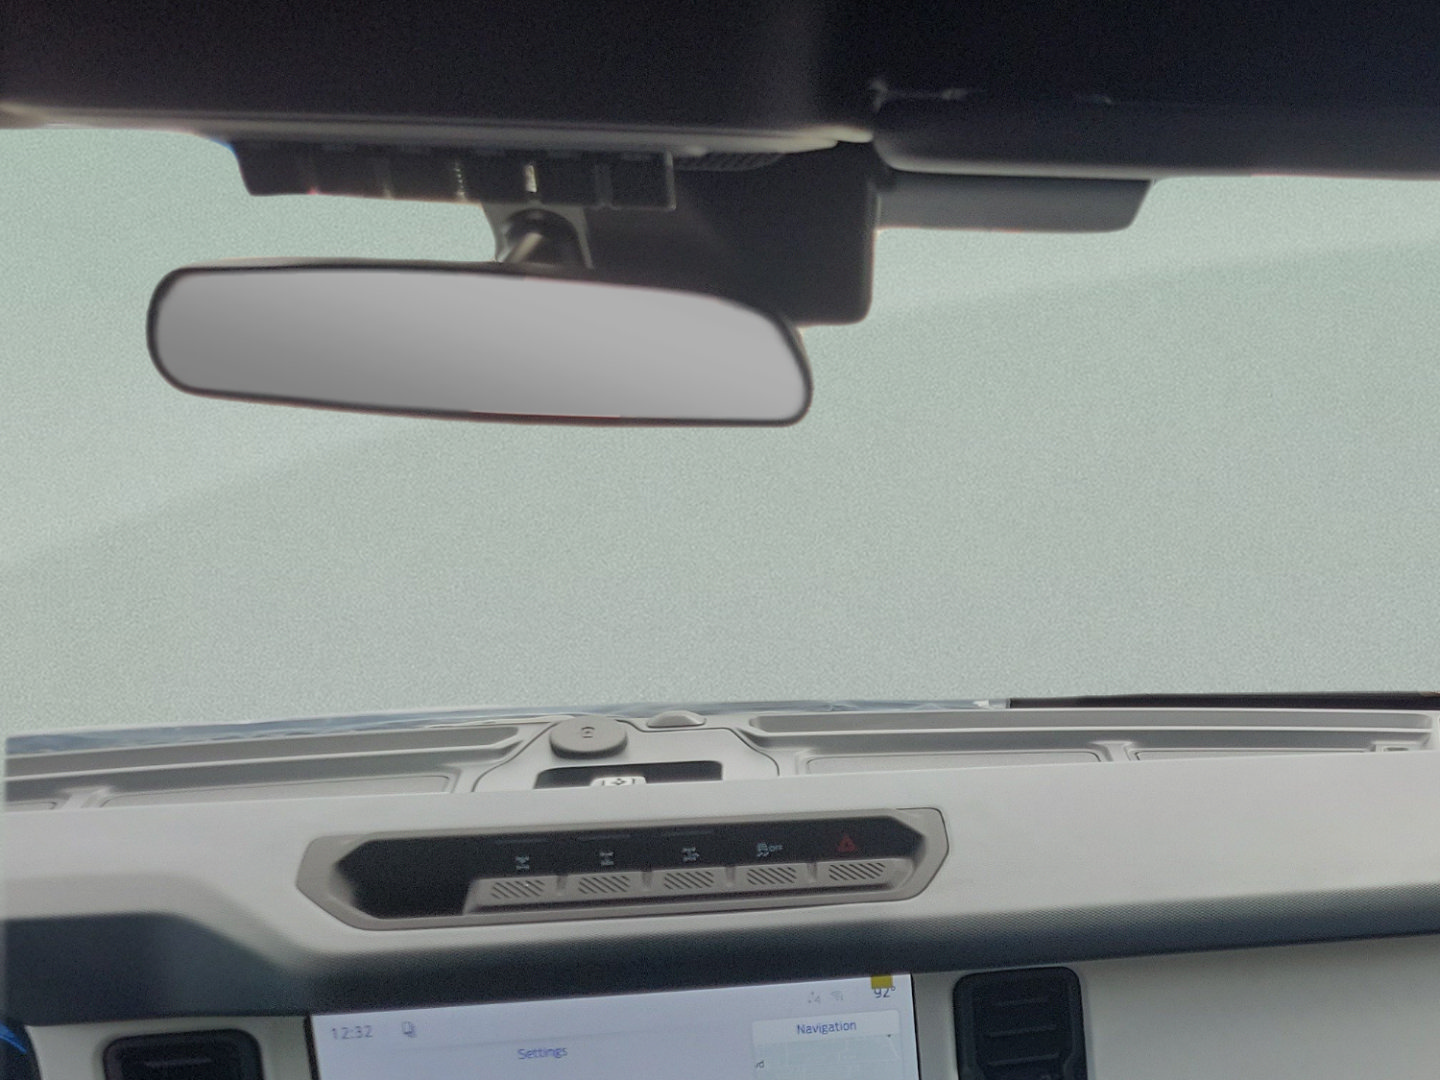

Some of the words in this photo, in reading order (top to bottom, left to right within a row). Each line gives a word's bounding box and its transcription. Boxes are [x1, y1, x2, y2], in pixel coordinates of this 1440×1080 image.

[331, 1025, 374, 1040] 12:32
[797, 1021, 857, 1035] Navigation
[517, 1047, 568, 1060] Settings
